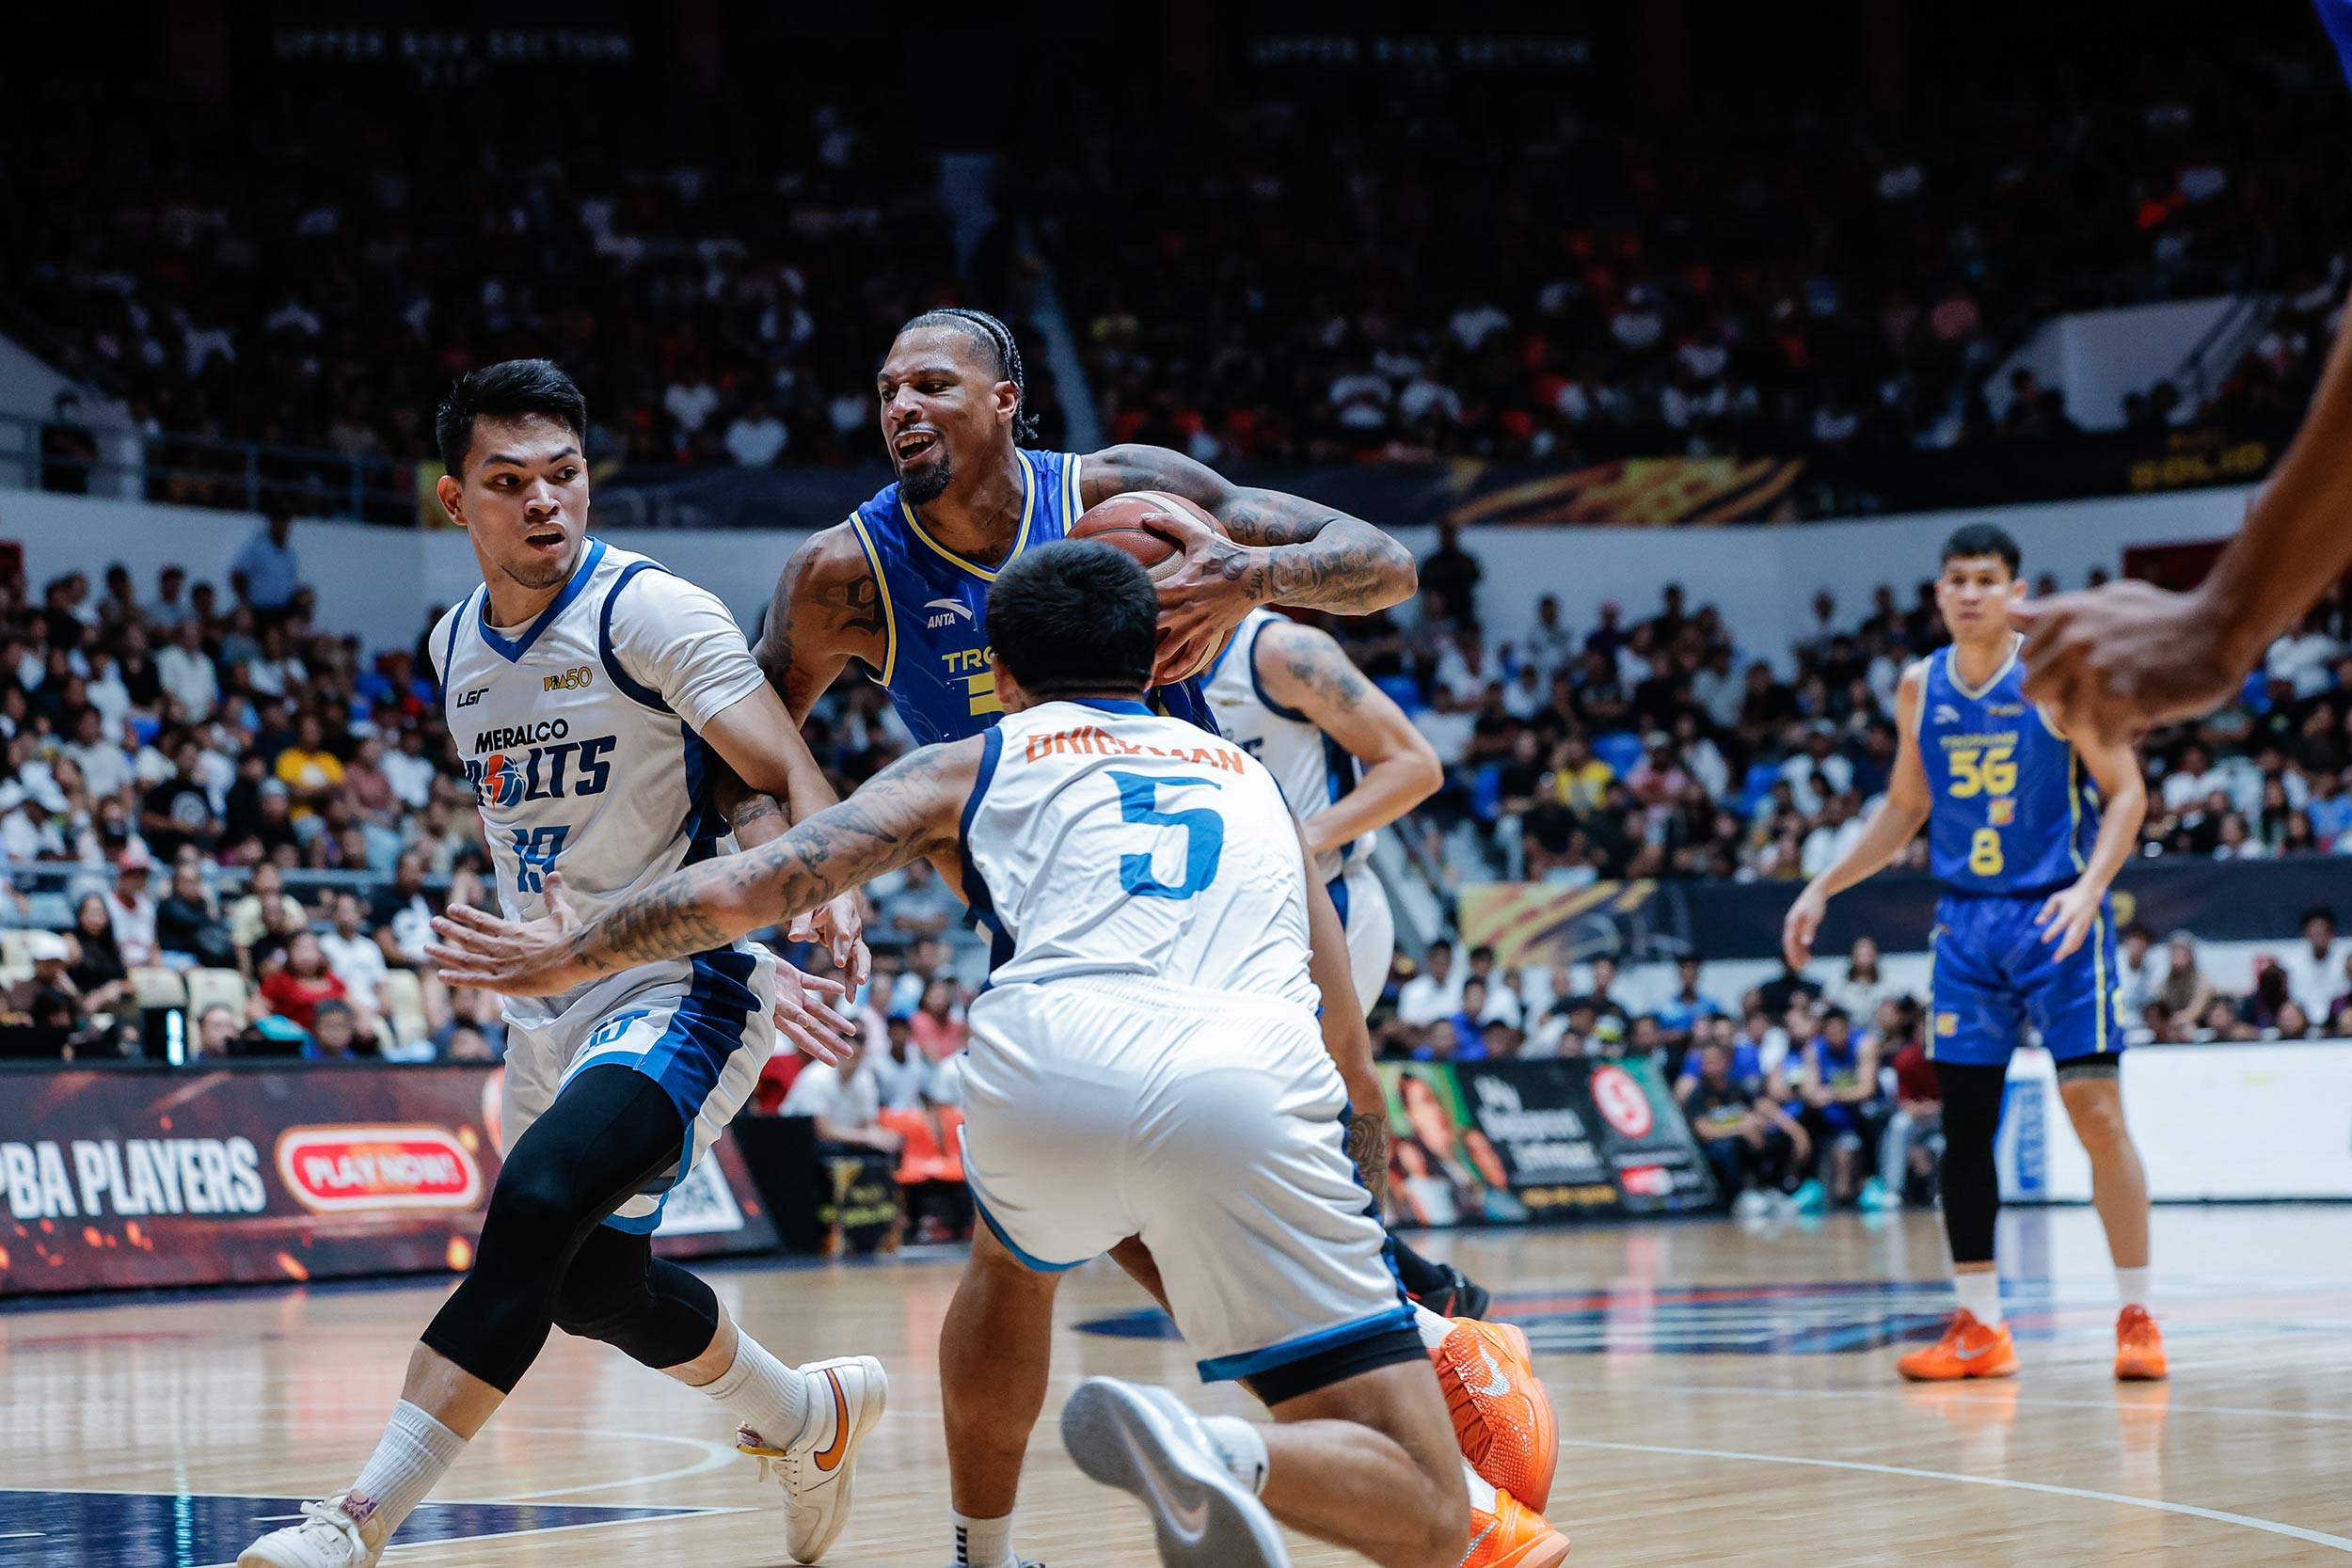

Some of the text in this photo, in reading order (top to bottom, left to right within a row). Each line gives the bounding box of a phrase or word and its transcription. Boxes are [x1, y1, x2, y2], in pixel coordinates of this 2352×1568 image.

[928, 612, 956, 629] ANTA
[474, 718, 569, 754] MERALCO
[1104, 770, 1224, 900] 5
[1969, 827, 2005, 876] 8
[0, 1135, 267, 1220] BA PLAYERS
[303, 1153, 378, 1190] PLAY
